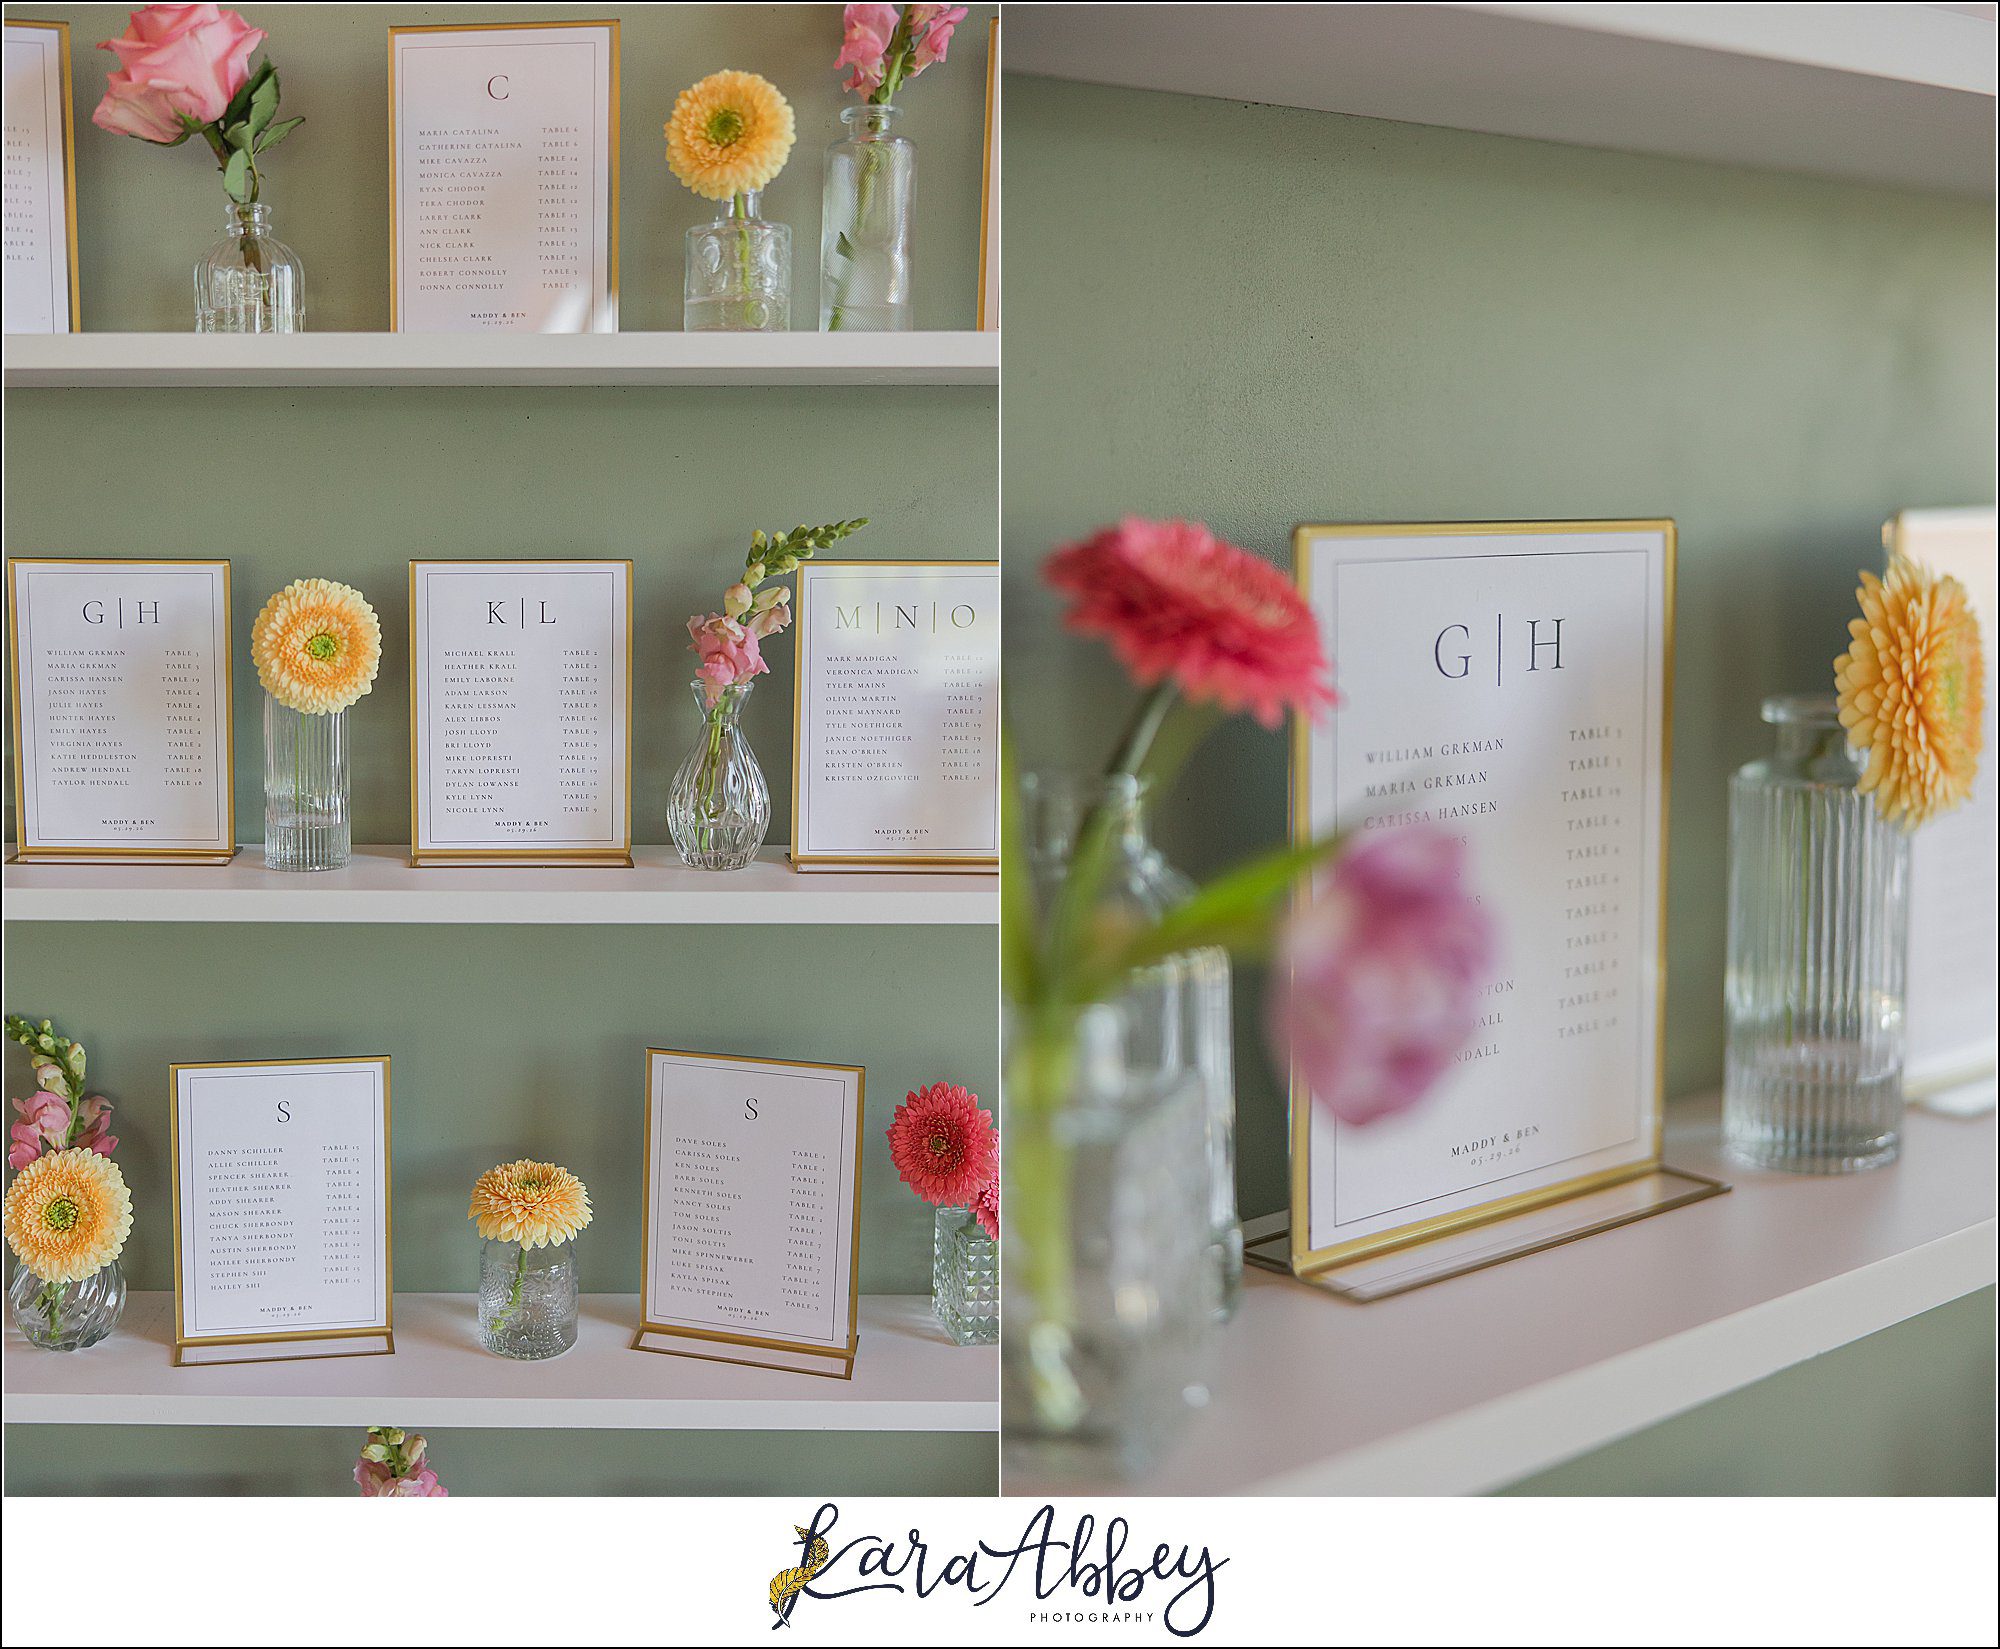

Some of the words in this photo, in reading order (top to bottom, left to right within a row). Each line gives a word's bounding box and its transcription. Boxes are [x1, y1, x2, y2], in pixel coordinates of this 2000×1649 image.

[487, 75, 510, 100] C
[452, 128, 500, 136] CATALINA
[541, 126, 570, 134] TABLE
[418, 143, 470, 151] CATHERINE
[475, 142, 522, 150] CATALINA
[444, 729, 466, 737] JOSH
[1569, 727, 1609, 741] TABLE
[1365, 747, 1433, 763] WILLIAM
[1440, 739, 1504, 755] GRKMAN
[1568, 756, 1609, 771] TABLE
[1365, 781, 1416, 796] MARIA
[1423, 772, 1487, 788] GRKMAN
[1560, 787, 1602, 802] TABLE
[1362, 811, 1431, 829] CARISSA
[1439, 802, 1497, 818] HANSEN
[1566, 815, 1607, 830] TABLE
[1565, 844, 1607, 860] TABLE
[1565, 873, 1607, 890] TABLE
[1565, 903, 1607, 919] TABLE
[1565, 932, 1607, 948] TABLE
[1564, 961, 1605, 978] TABLE
[1557, 991, 1599, 1009] TABLE
[277, 1101, 291, 1122] S
[744, 1098, 758, 1120] S
[675, 1137, 698, 1145] DAVE
[701, 1140, 727, 1148] SOLES
[1451, 1137, 1501, 1159] MADDY
[1502, 1133, 1510, 1143] &
[1516, 1126, 1540, 1139] BEN
[241, 1147, 284, 1155] SCHILLER
[675, 1149, 711, 1159] CARISSA
[715, 1154, 740, 1162] SOLES
[208, 1173, 246, 1181] SPENCER
[243, 1220, 294, 1228] SHERBONDY
[672, 1224, 699, 1232] JASON
[702, 1227, 732, 1236] SOLTIS
[245, 1244, 297, 1252] SHERBONDY
[787, 1238, 814, 1247] TABLE
[672, 1248, 692, 1256] MIKE
[695, 1252, 754, 1265] SPINNEWEBER
[671, 1272, 698, 1281] KAYLA
[701, 1277, 730, 1286] SPISAK
[781, 1288, 808, 1296] TABLE
[717, 1305, 744, 1316] MADDY
